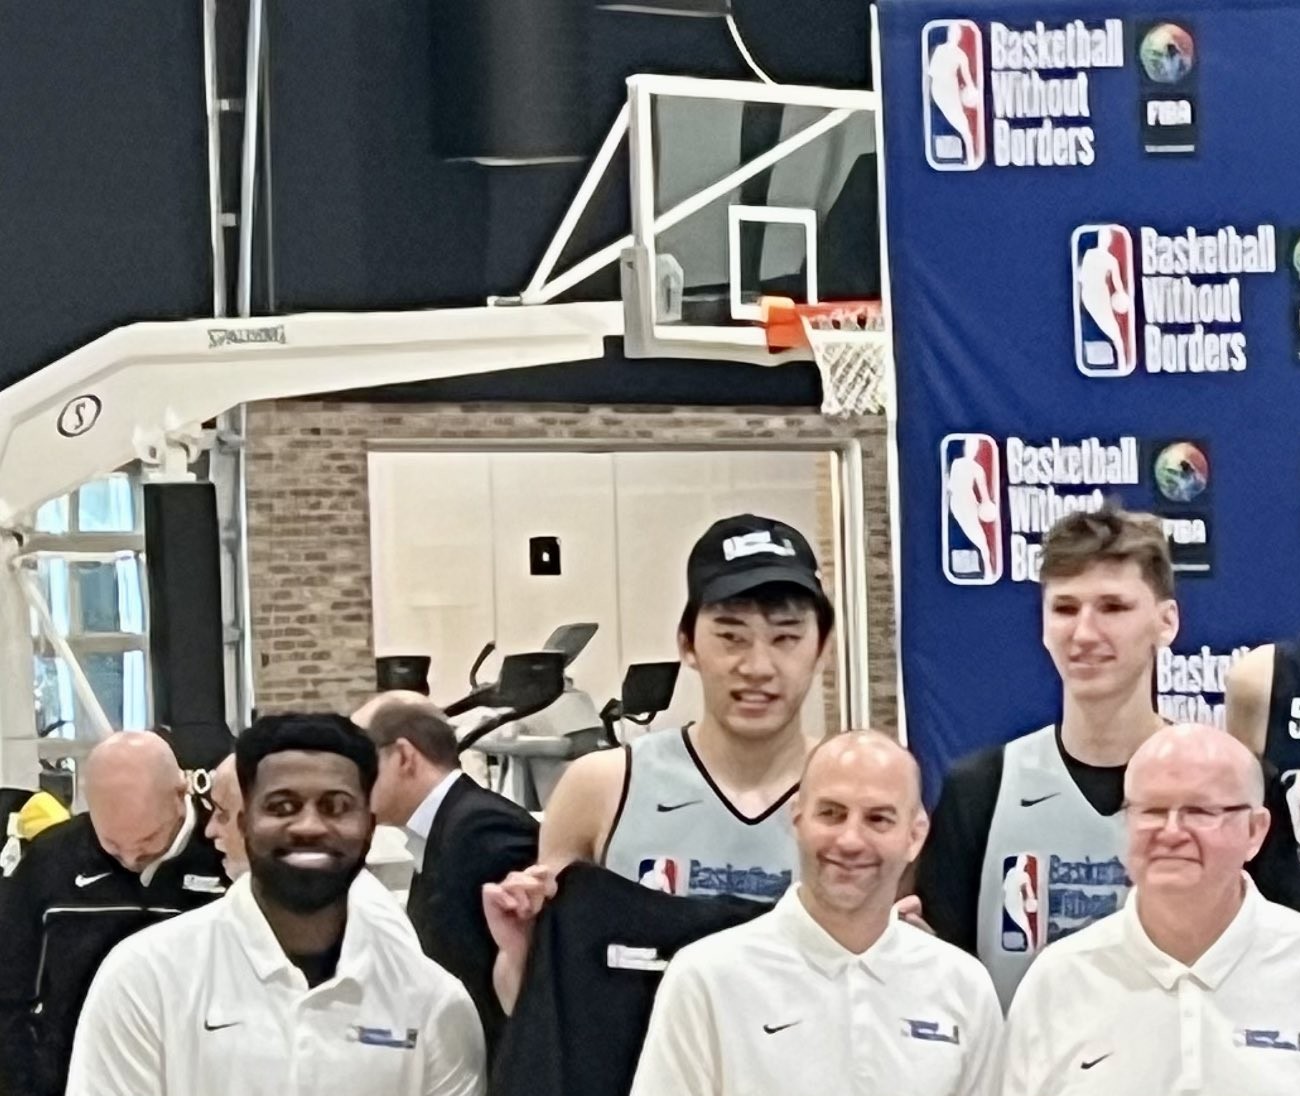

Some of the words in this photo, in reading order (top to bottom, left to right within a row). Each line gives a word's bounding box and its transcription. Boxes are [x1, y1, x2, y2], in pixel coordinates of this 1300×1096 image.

[991, 19, 1123, 68] Basketball
[991, 70, 1089, 117] Without
[1147, 100, 1191, 125] FIBA
[994, 119, 1094, 166] Borders
[1141, 225, 1275, 274] Basketball
[1142, 276, 1241, 323] Without
[1145, 324, 1246, 372] Borders
[1007, 437, 1138, 484] Basketball
